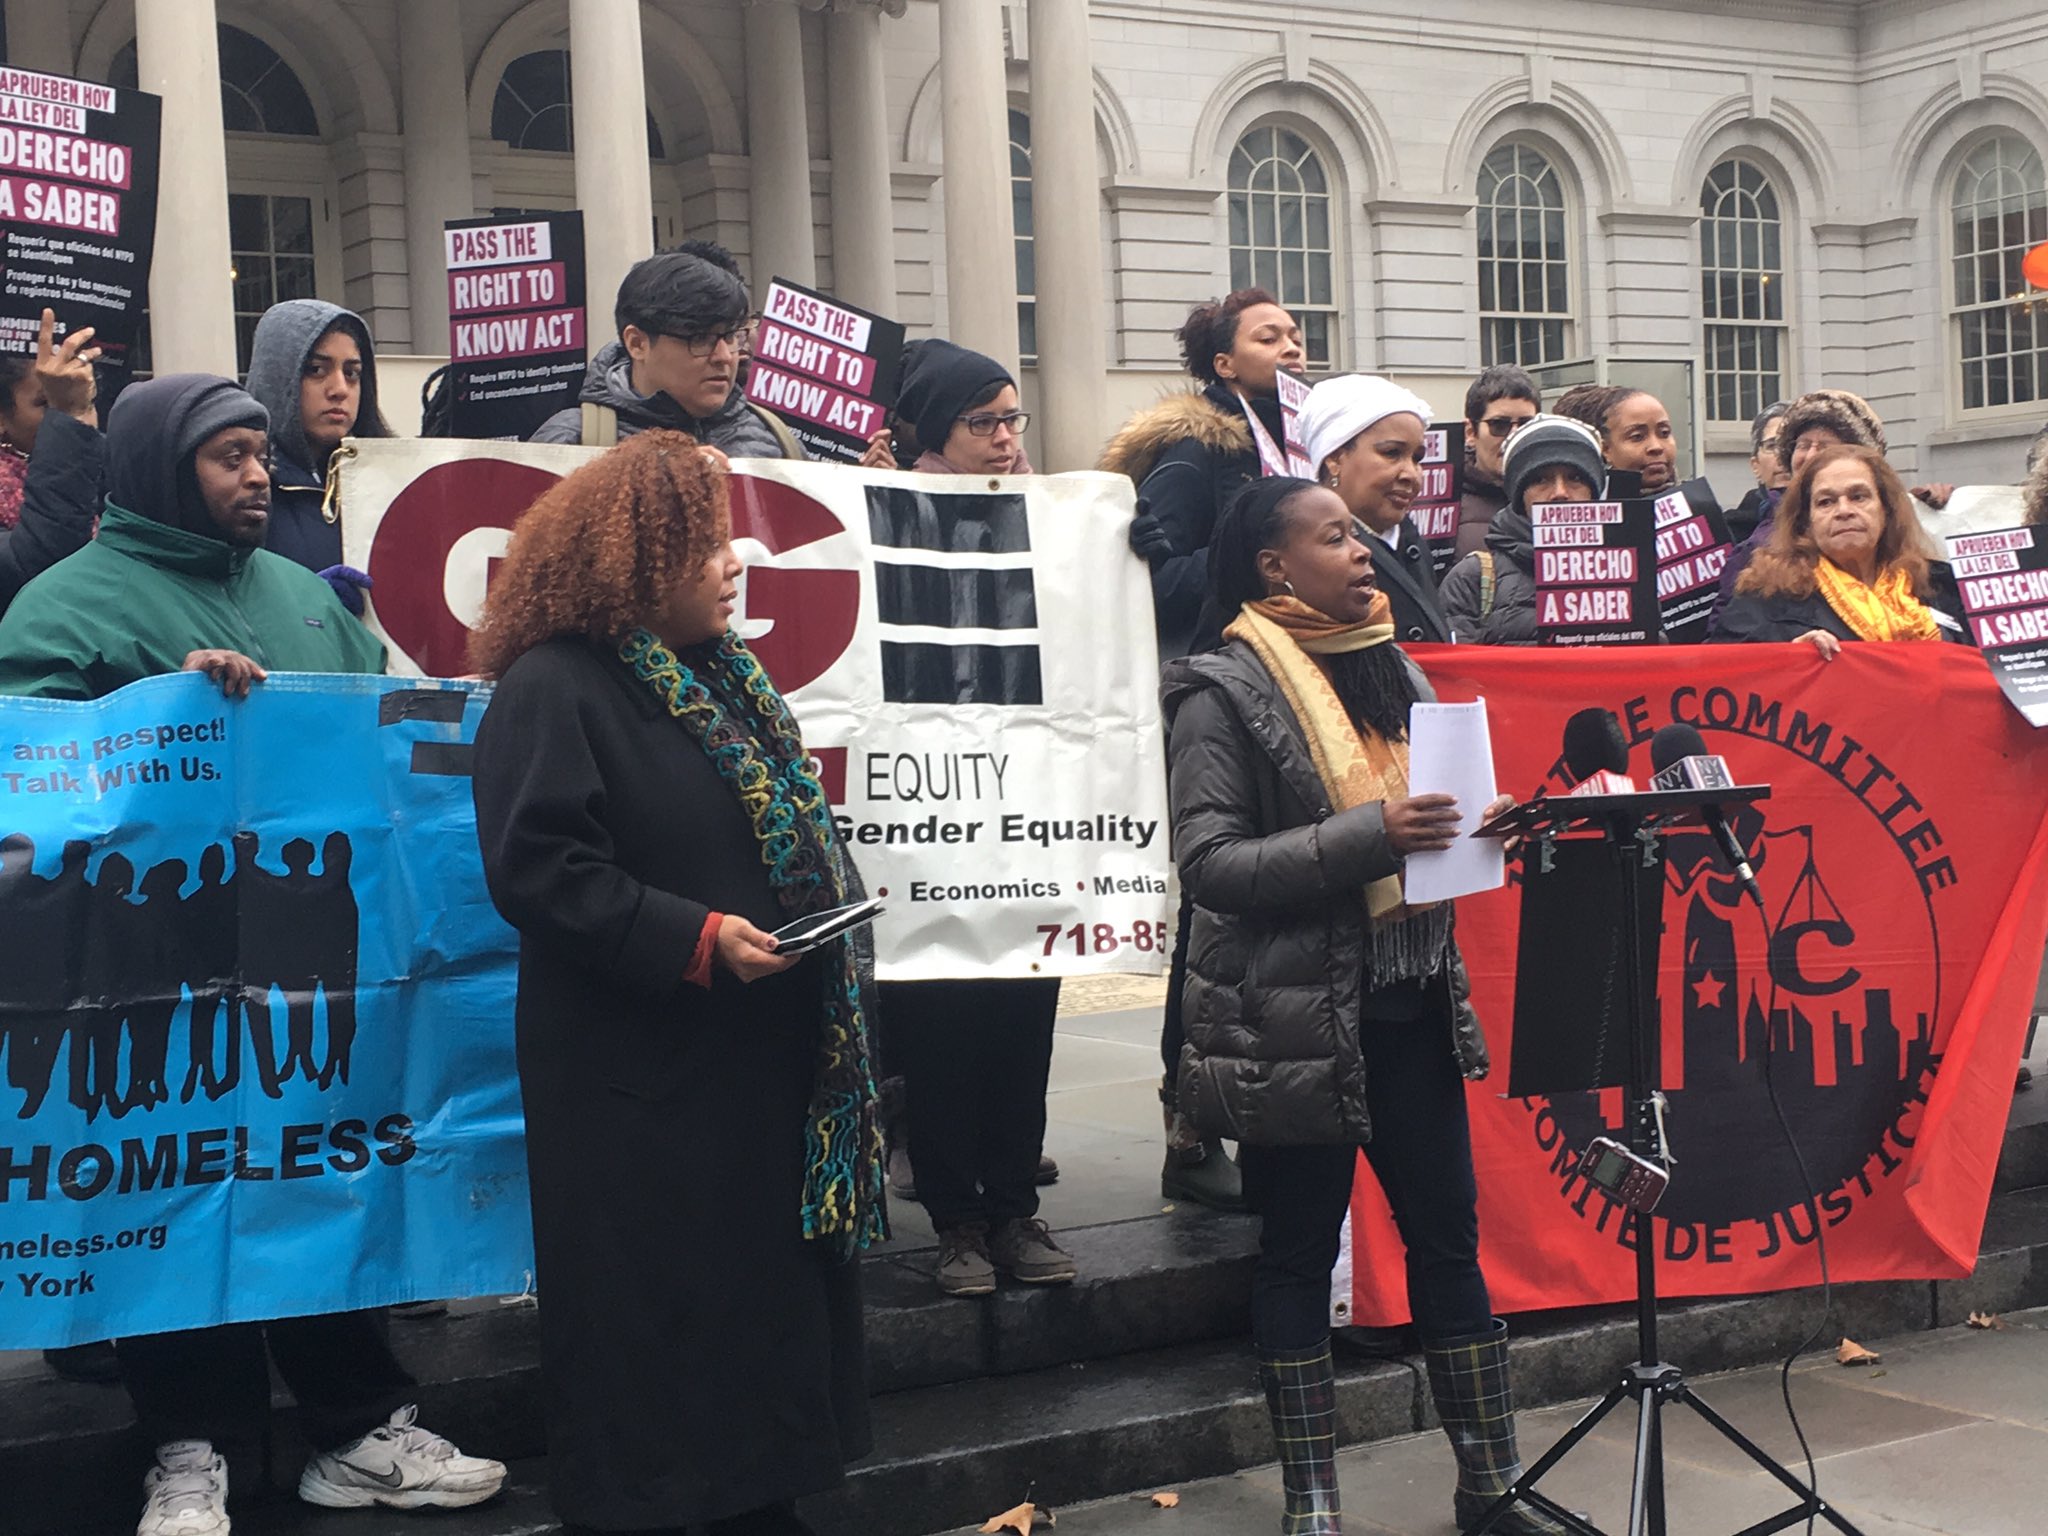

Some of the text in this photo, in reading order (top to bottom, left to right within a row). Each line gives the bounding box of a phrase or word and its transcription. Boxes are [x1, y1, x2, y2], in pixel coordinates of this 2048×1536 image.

[0, 71, 111, 110] APRUEBEN HOY
[0, 102, 79, 131] LA LEY DEL
[0, 129, 125, 184] DERECHO
[0, 179, 116, 233] A SABER
[452, 226, 537, 262] PASS THE
[454, 268, 554, 310] RIGHT TO
[772, 288, 857, 342] PASS THE
[456, 313, 574, 357] KNOW ACT
[762, 325, 863, 387] RIGHT TO
[751, 367, 874, 435] KNOW ACT
[1431, 468, 1447, 496] TO
[1431, 506, 1455, 535] ACT
[1541, 502, 1618, 524] APRUEBEN HOY
[1541, 527, 1599, 545] LA LEY DEL
[1676, 522, 1703, 549] TO
[1955, 532, 2028, 557] APRUEBEN HOY
[1542, 549, 1633, 582] DERECHO
[1695, 549, 1726, 582] ACT
[1959, 553, 2014, 575] LA LEY DEL
[1543, 593, 1559, 623] A
[1564, 590, 1629, 622] SABER
[1965, 569, 2048, 610] DERECHO
[1979, 618, 1997, 646] A
[13, 717, 225, 761] and Respect!
[2, 756, 221, 794] Talk With Us.
[866, 752, 1009, 803] EQUITY
[1670, 686, 1958, 897] COMMITTEE
[832, 814, 1158, 848] Gender Equality
[910, 875, 1166, 902] Economics Media
[1036, 921, 1167, 956] 718-85
[2, 1114, 416, 1202] HOMELESS
[1665, 1218, 1733, 1264] DE
[17, 1269, 95, 1297] York
